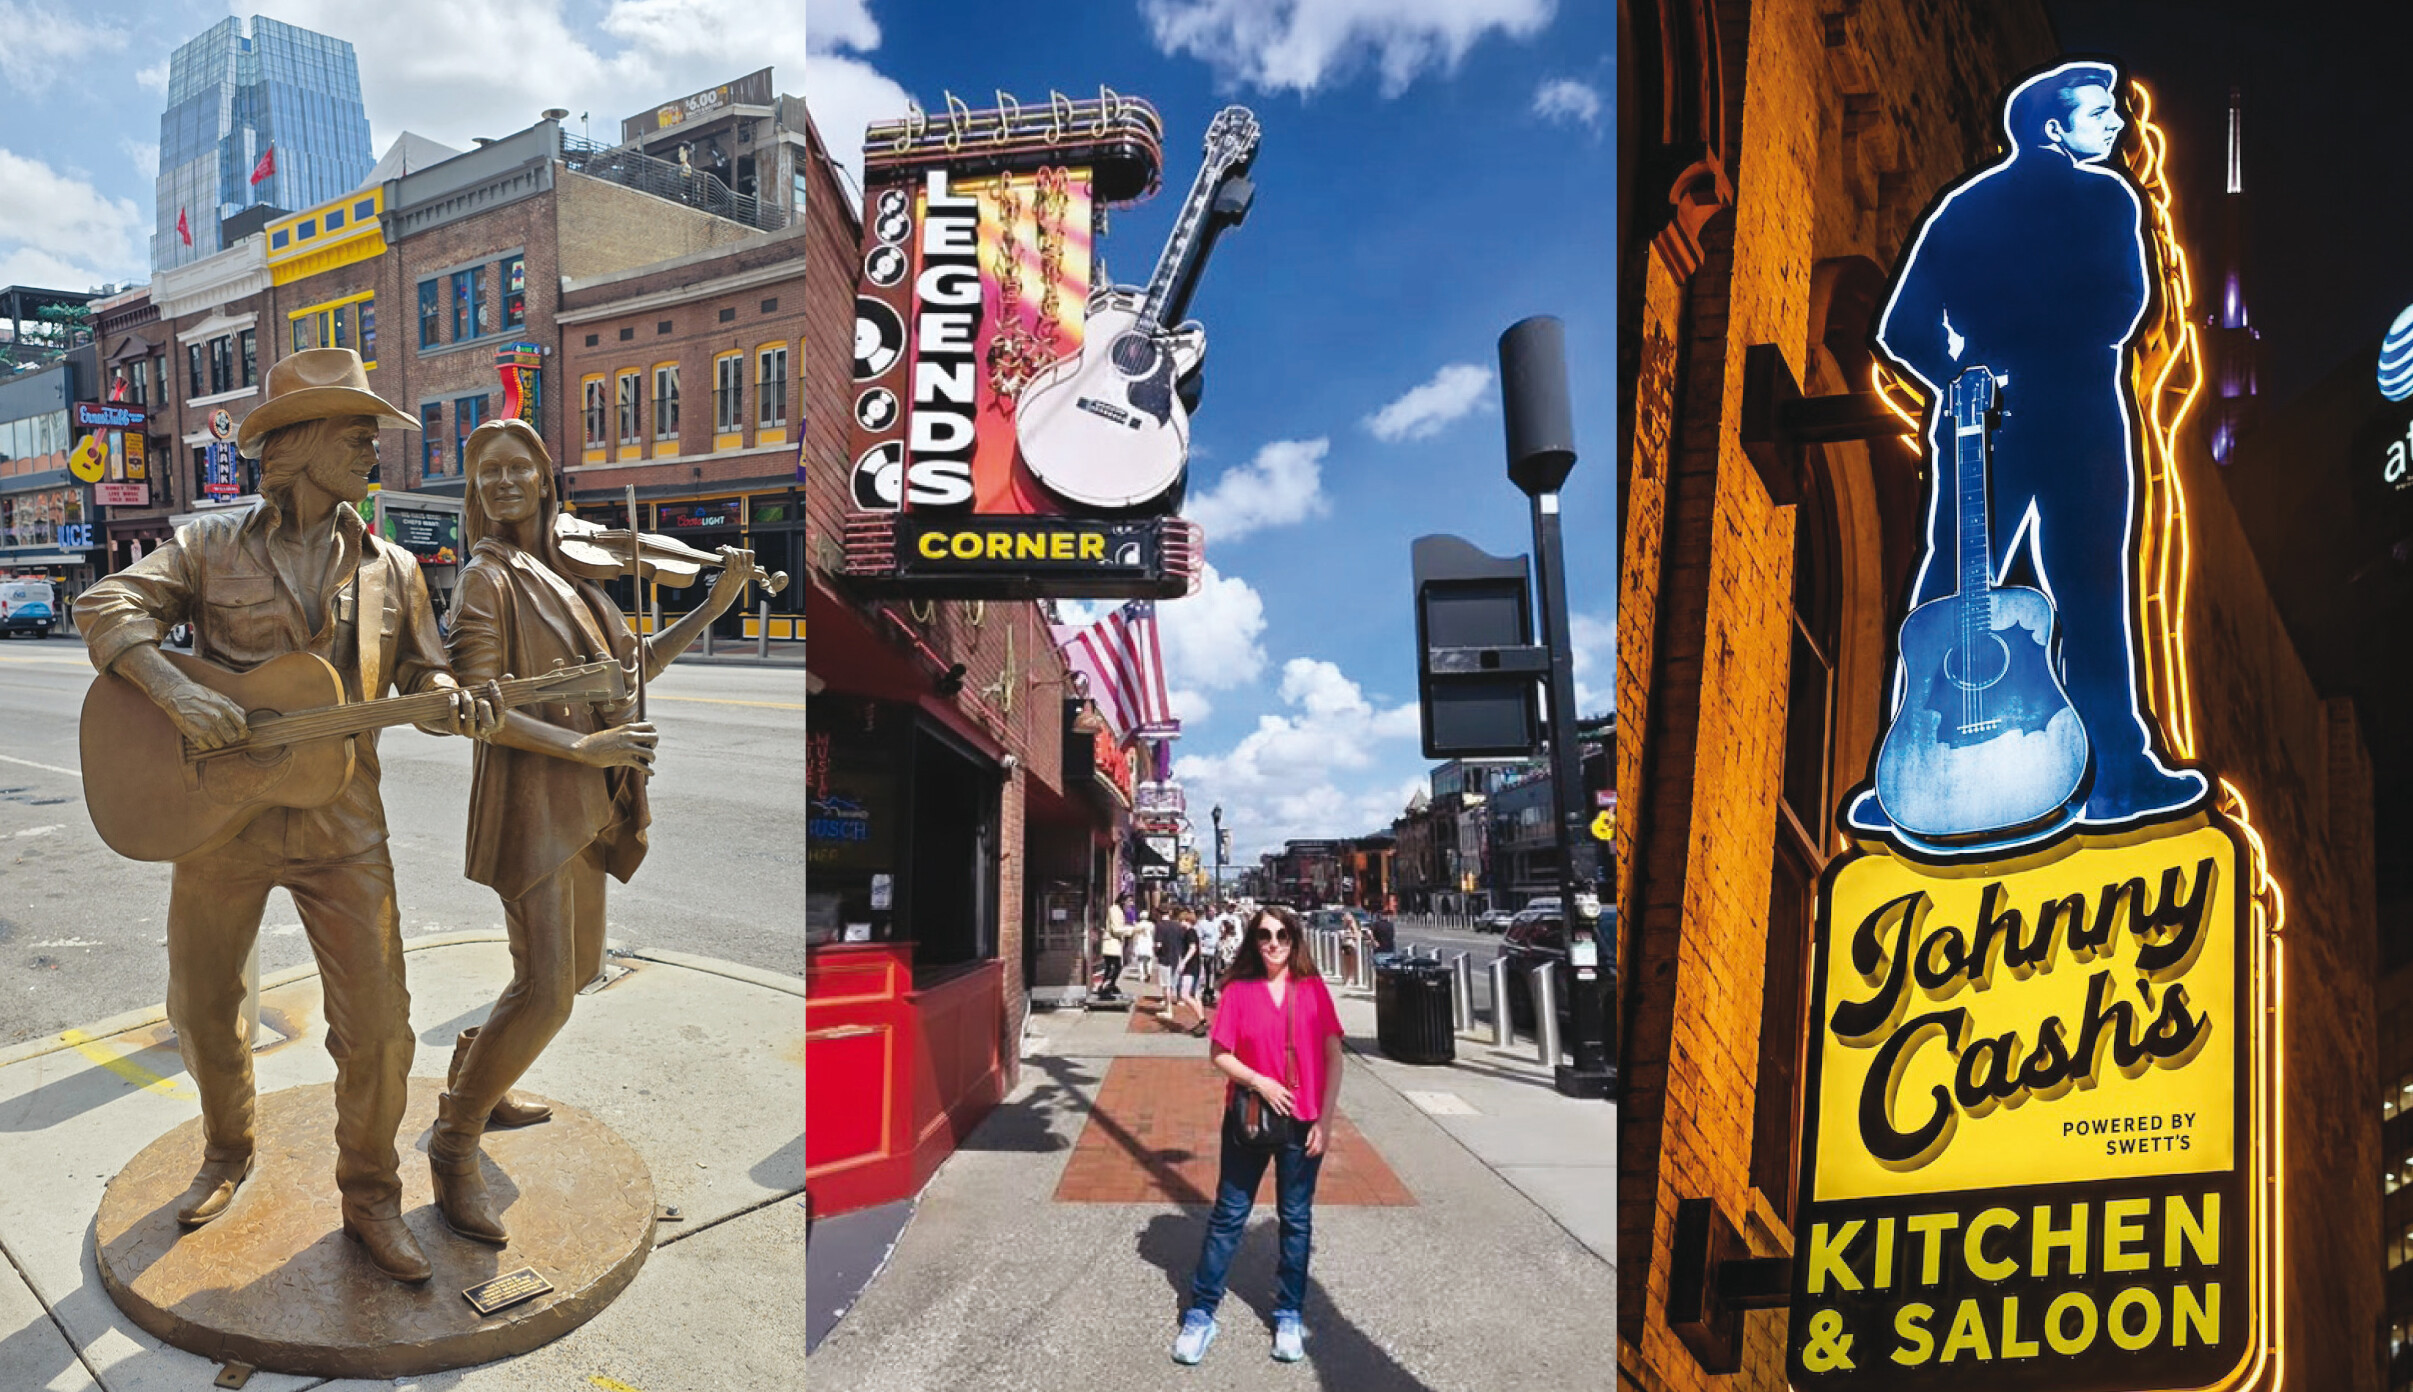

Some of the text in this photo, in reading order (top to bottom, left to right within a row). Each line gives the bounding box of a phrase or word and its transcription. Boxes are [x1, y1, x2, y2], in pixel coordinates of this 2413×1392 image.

[908, 169, 981, 505] LEGENDS
[219, 443, 230, 484] HANK
[702, 516, 725, 526] LIGHT
[918, 532, 1105, 560] CORNER
[1830, 857, 2217, 1040] Johnny
[1858, 969, 2209, 1165] Cash's
[2063, 1113, 2196, 1137] POWERED BY
[2106, 1135, 2191, 1155] SWETT'S
[1807, 1192, 2220, 1294] KITCHEN
[1802, 1283, 2220, 1374] & SALOON
